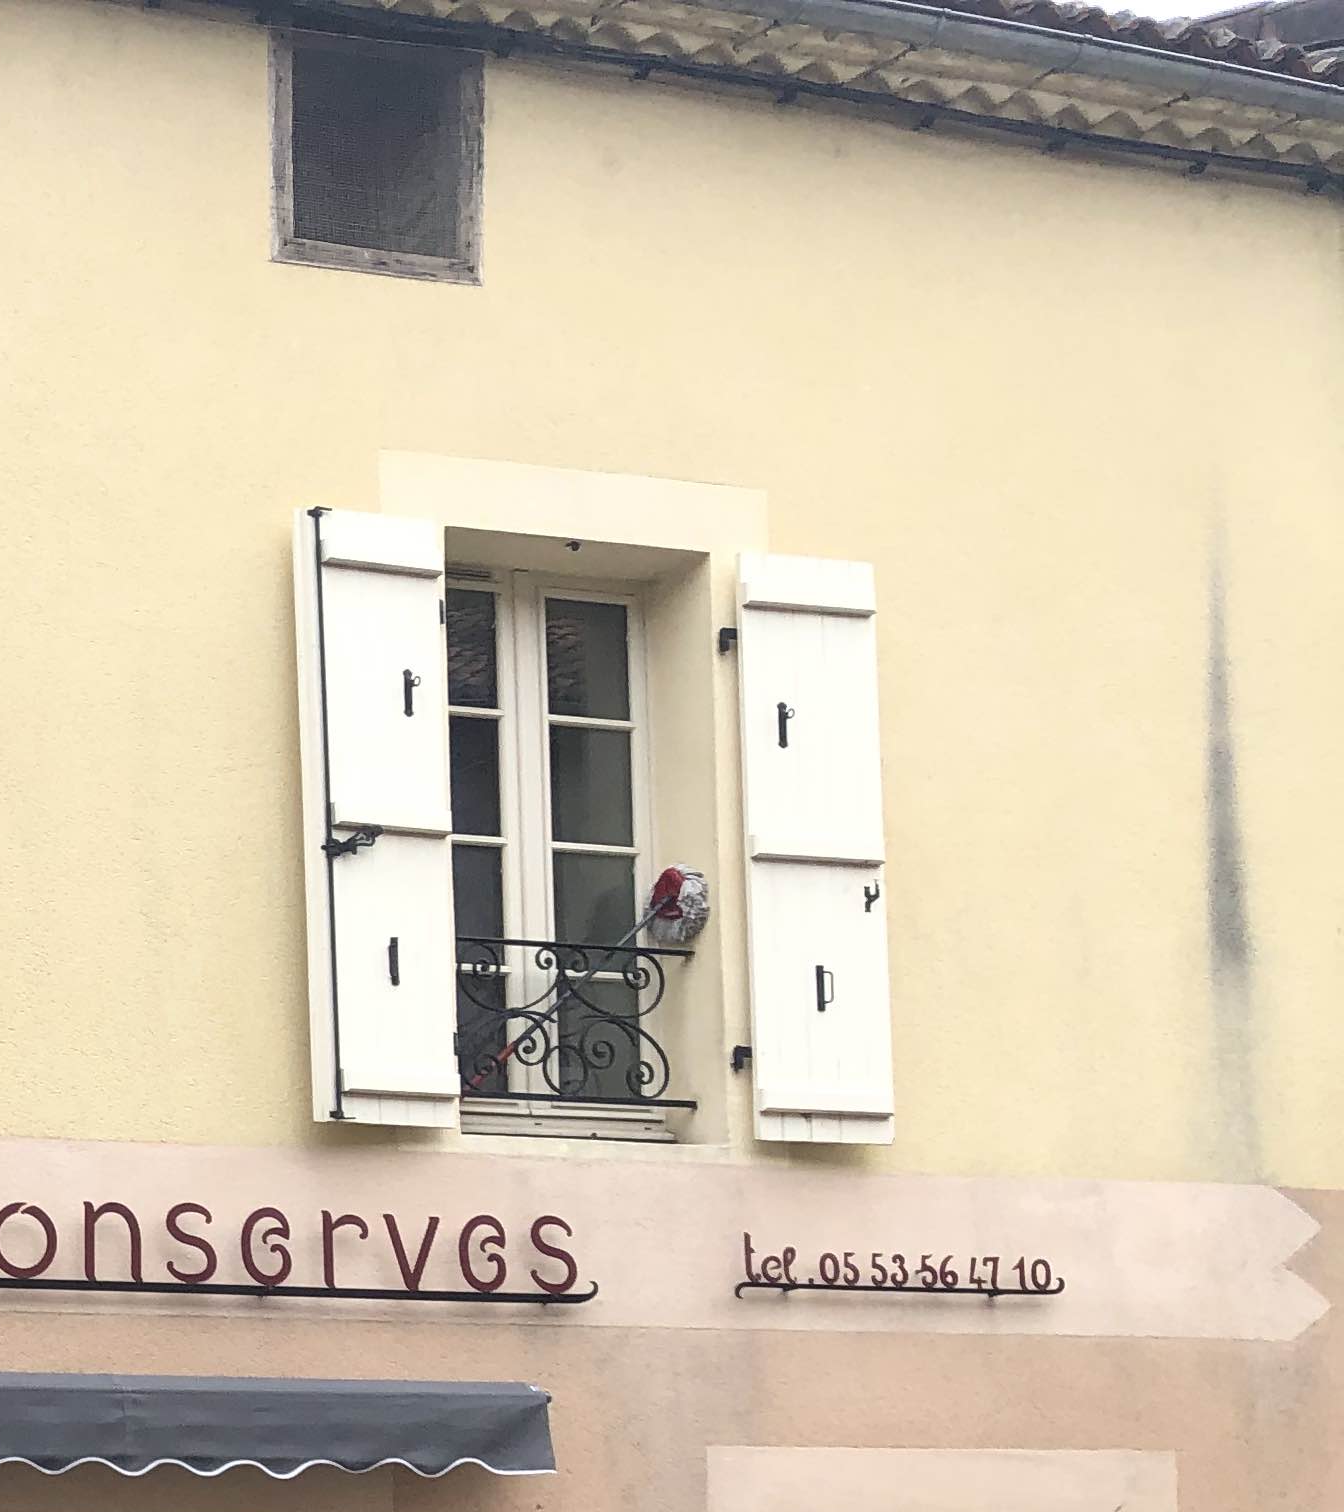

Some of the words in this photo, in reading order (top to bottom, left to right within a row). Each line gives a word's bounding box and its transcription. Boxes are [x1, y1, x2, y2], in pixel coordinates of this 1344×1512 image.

[819, 1252, 860, 1286] 05
[871, 1252, 909, 1287] 53
[915, 1253, 959, 1288] 56
[969, 1256, 1001, 1290] 47
[1012, 1256, 1053, 1291] 10
